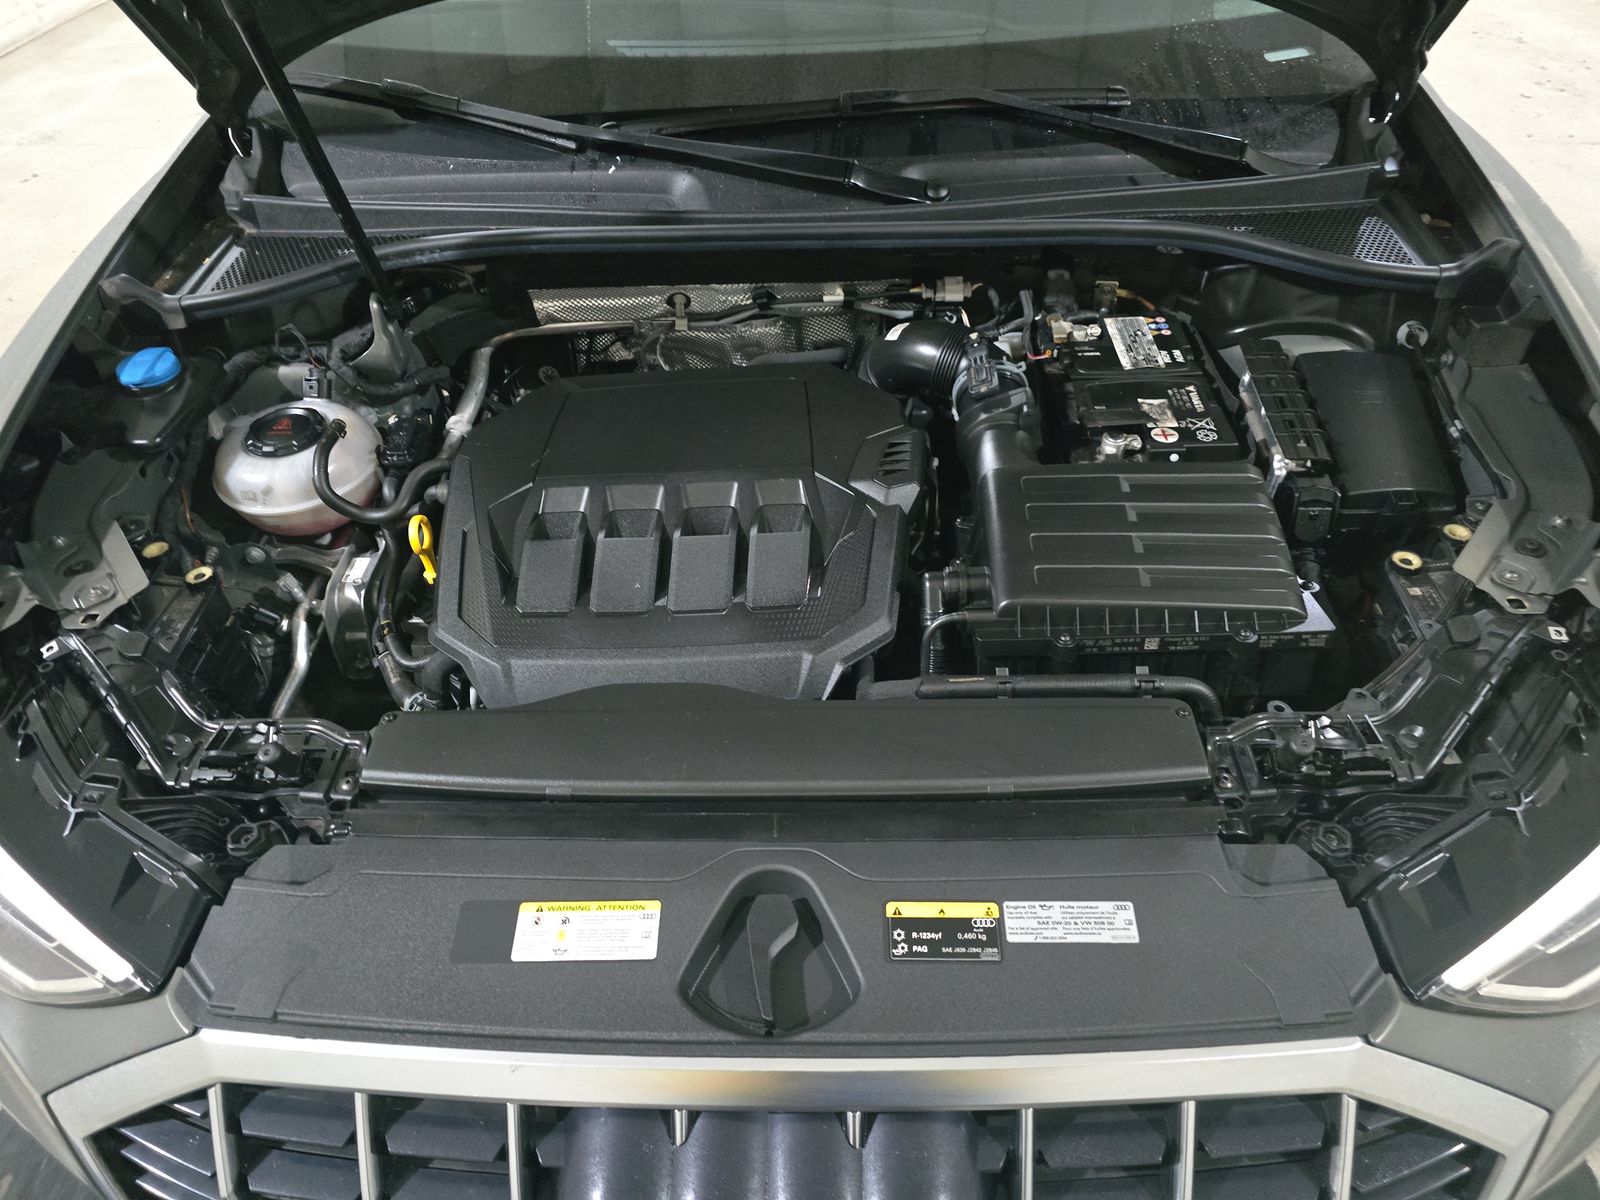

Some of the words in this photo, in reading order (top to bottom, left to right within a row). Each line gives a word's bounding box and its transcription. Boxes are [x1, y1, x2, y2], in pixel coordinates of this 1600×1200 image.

[1189, 391, 1205, 413] VARTA
[911, 932, 942, 940] R-1234yf
[977, 933, 987, 941] kg
[912, 945, 928, 953] PAG
